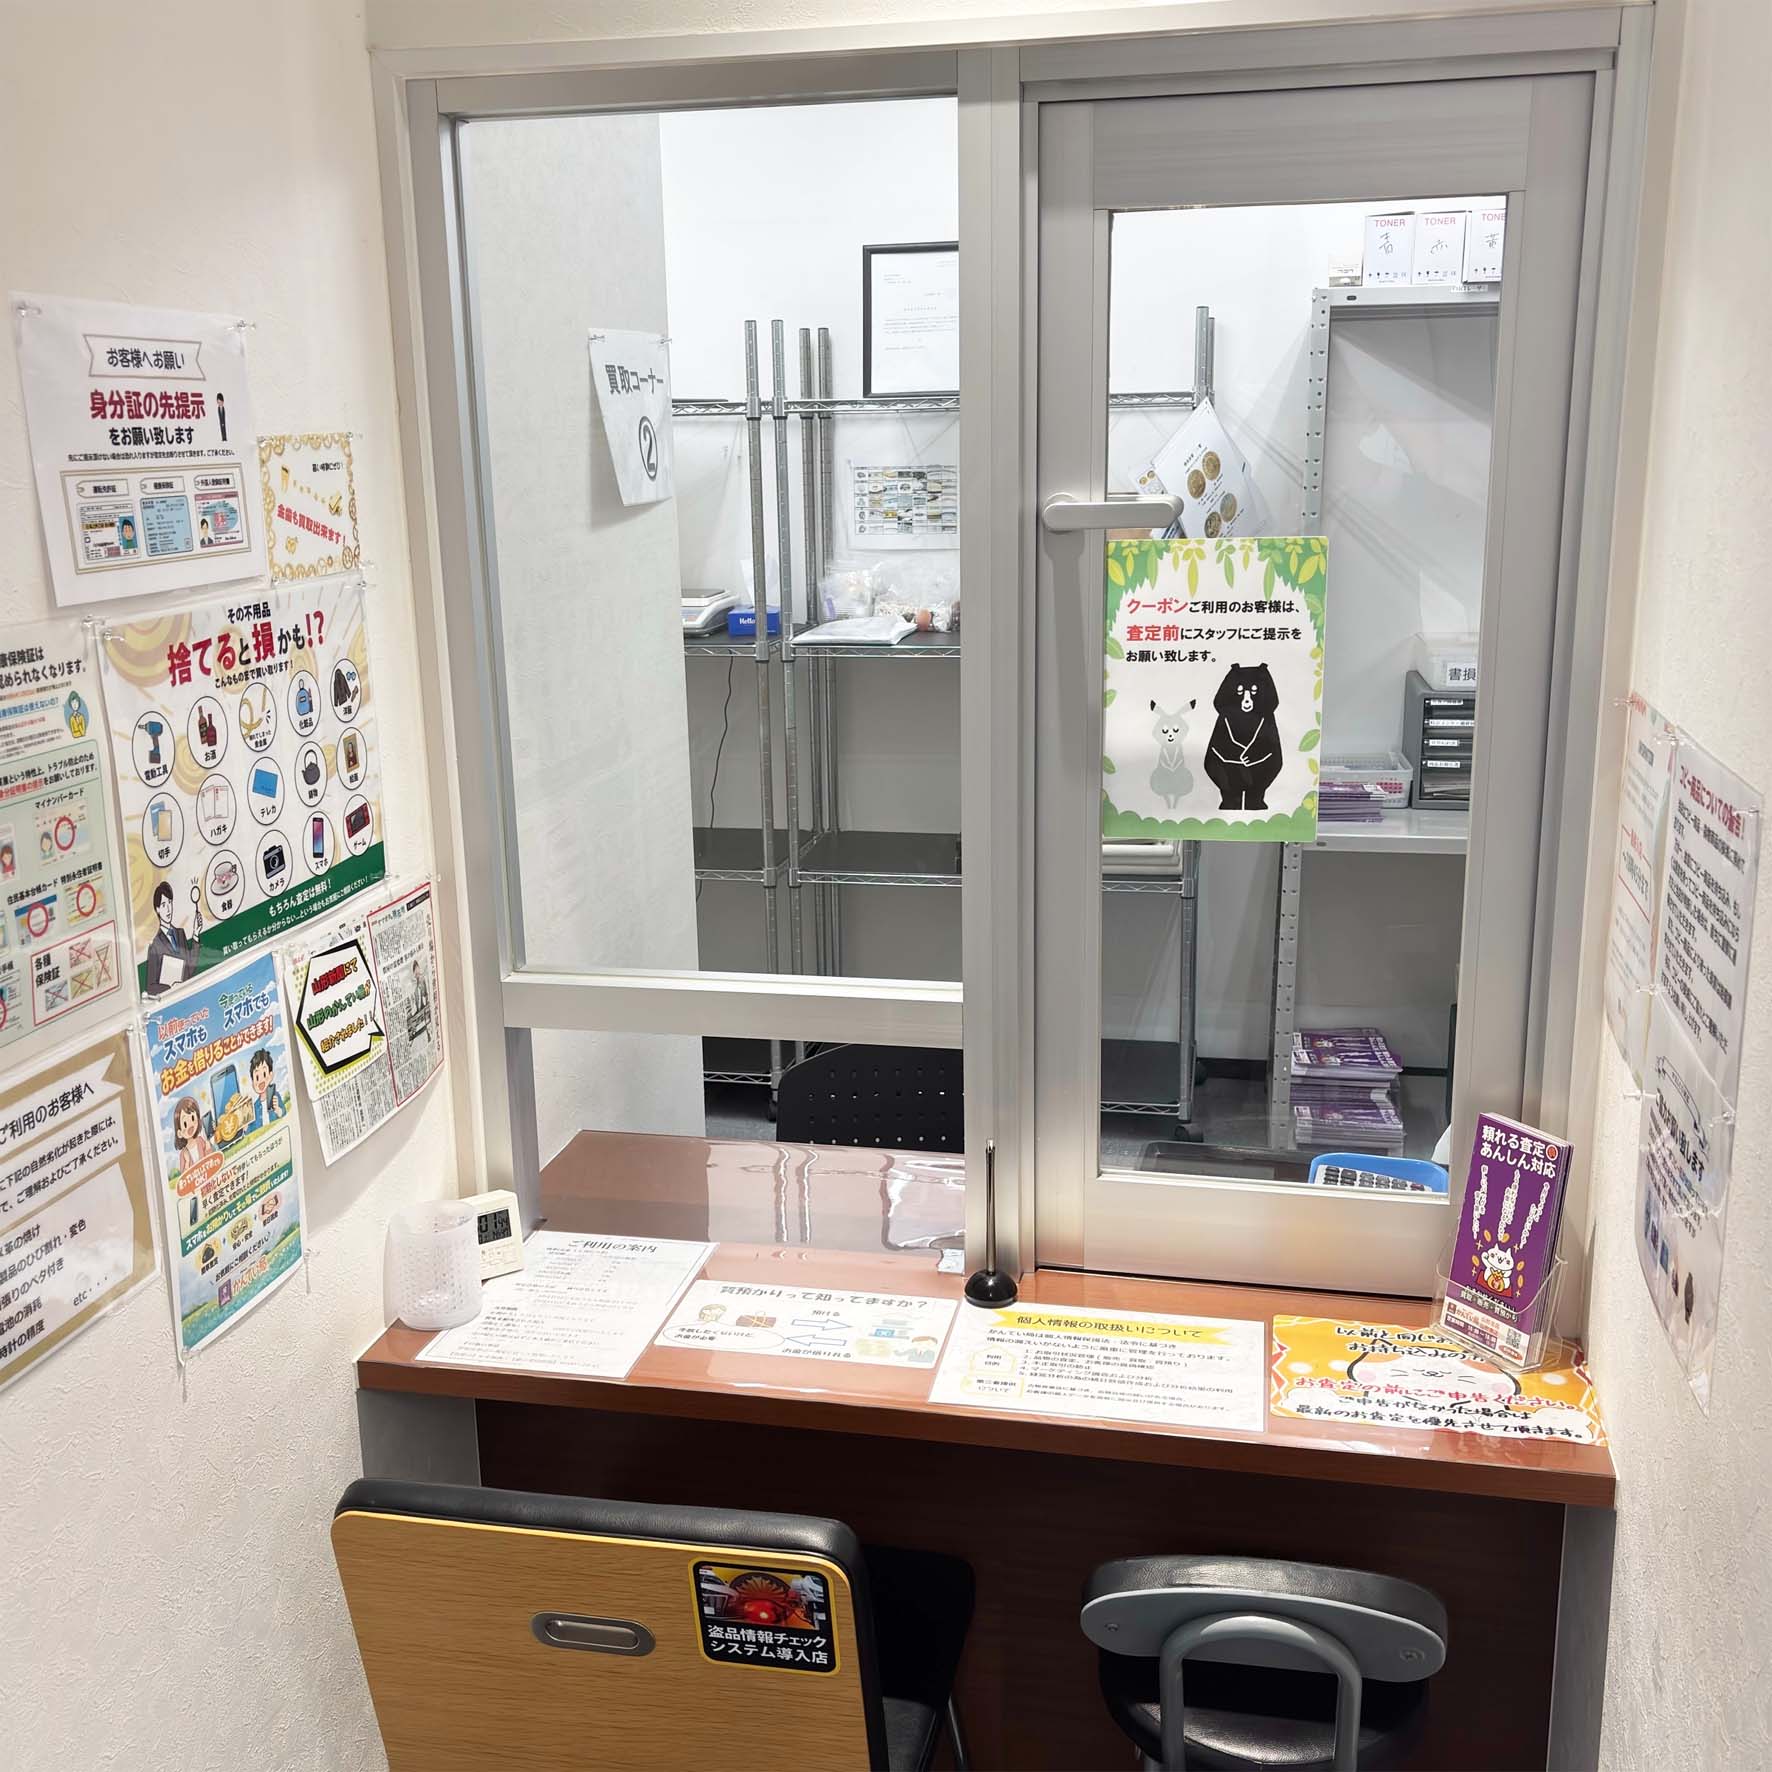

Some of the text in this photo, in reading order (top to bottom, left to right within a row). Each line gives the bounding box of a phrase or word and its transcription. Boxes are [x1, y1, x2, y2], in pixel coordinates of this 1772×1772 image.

[1375, 218, 1406, 228] TONER
[1424, 217, 1456, 226] TONER
[106, 347, 185, 370] お客様へお願い
[605, 364, 664, 395] 買取コーナー
[90, 389, 207, 420] 身分証の先提示
[109, 426, 195, 446] をお願い致します
[227, 602, 271, 624] その不用品
[1127, 597, 1300, 615] クーポンご利用のお客様は、
[1126, 624, 1302, 642] 査定前にスタッフにご提示を
[167, 610, 326, 687] 捨てると損かも!?
[1126, 650, 1217, 663] お願い致します。
[215, 661, 295, 689] こんなものまで買い取ります!
[204, 749, 218, 762] お酒
[144, 763, 169, 781] 電動工具
[35, 787, 85, 809] マイナンバーカード
[259, 804, 277, 818] テレカ
[210, 823, 228, 837] ハガキ
[158, 846, 171, 860] 切手
[313, 857, 329, 871] スマホ
[268, 877, 285, 892] カメラ
[269, 878, 332, 917] もちろん査定は無料!
[35, 953, 51, 971] 各種
[223, 992, 271, 1031] スマホでも
[160, 1014, 274, 1097] お金を借りることができます!
[164, 1025, 208, 1063] スマホも
[1481, 1125, 1546, 1159] 頼れる査定
[1480, 1141, 1557, 1179] あんしん対応
[568, 1239, 657, 1253] ご利用の案内
[0, 1257, 65, 1312] 張りのベタ付き
[719, 1285, 928, 1310] 質預かりって知ってますか?
[1016, 1314, 1203, 1338] 個人情報の取扱いについて
[1295, 1377, 1583, 1412] お査定の前にご申告ください。
[1338, 1396, 1532, 1421] ご申告がなかった場合は
[1296, 1403, 1584, 1440] 最新のお査定を優先させて頂きます。
[707, 1624, 827, 1649] 盗品情報チェック
[710, 1640, 829, 1665] システム導入店
